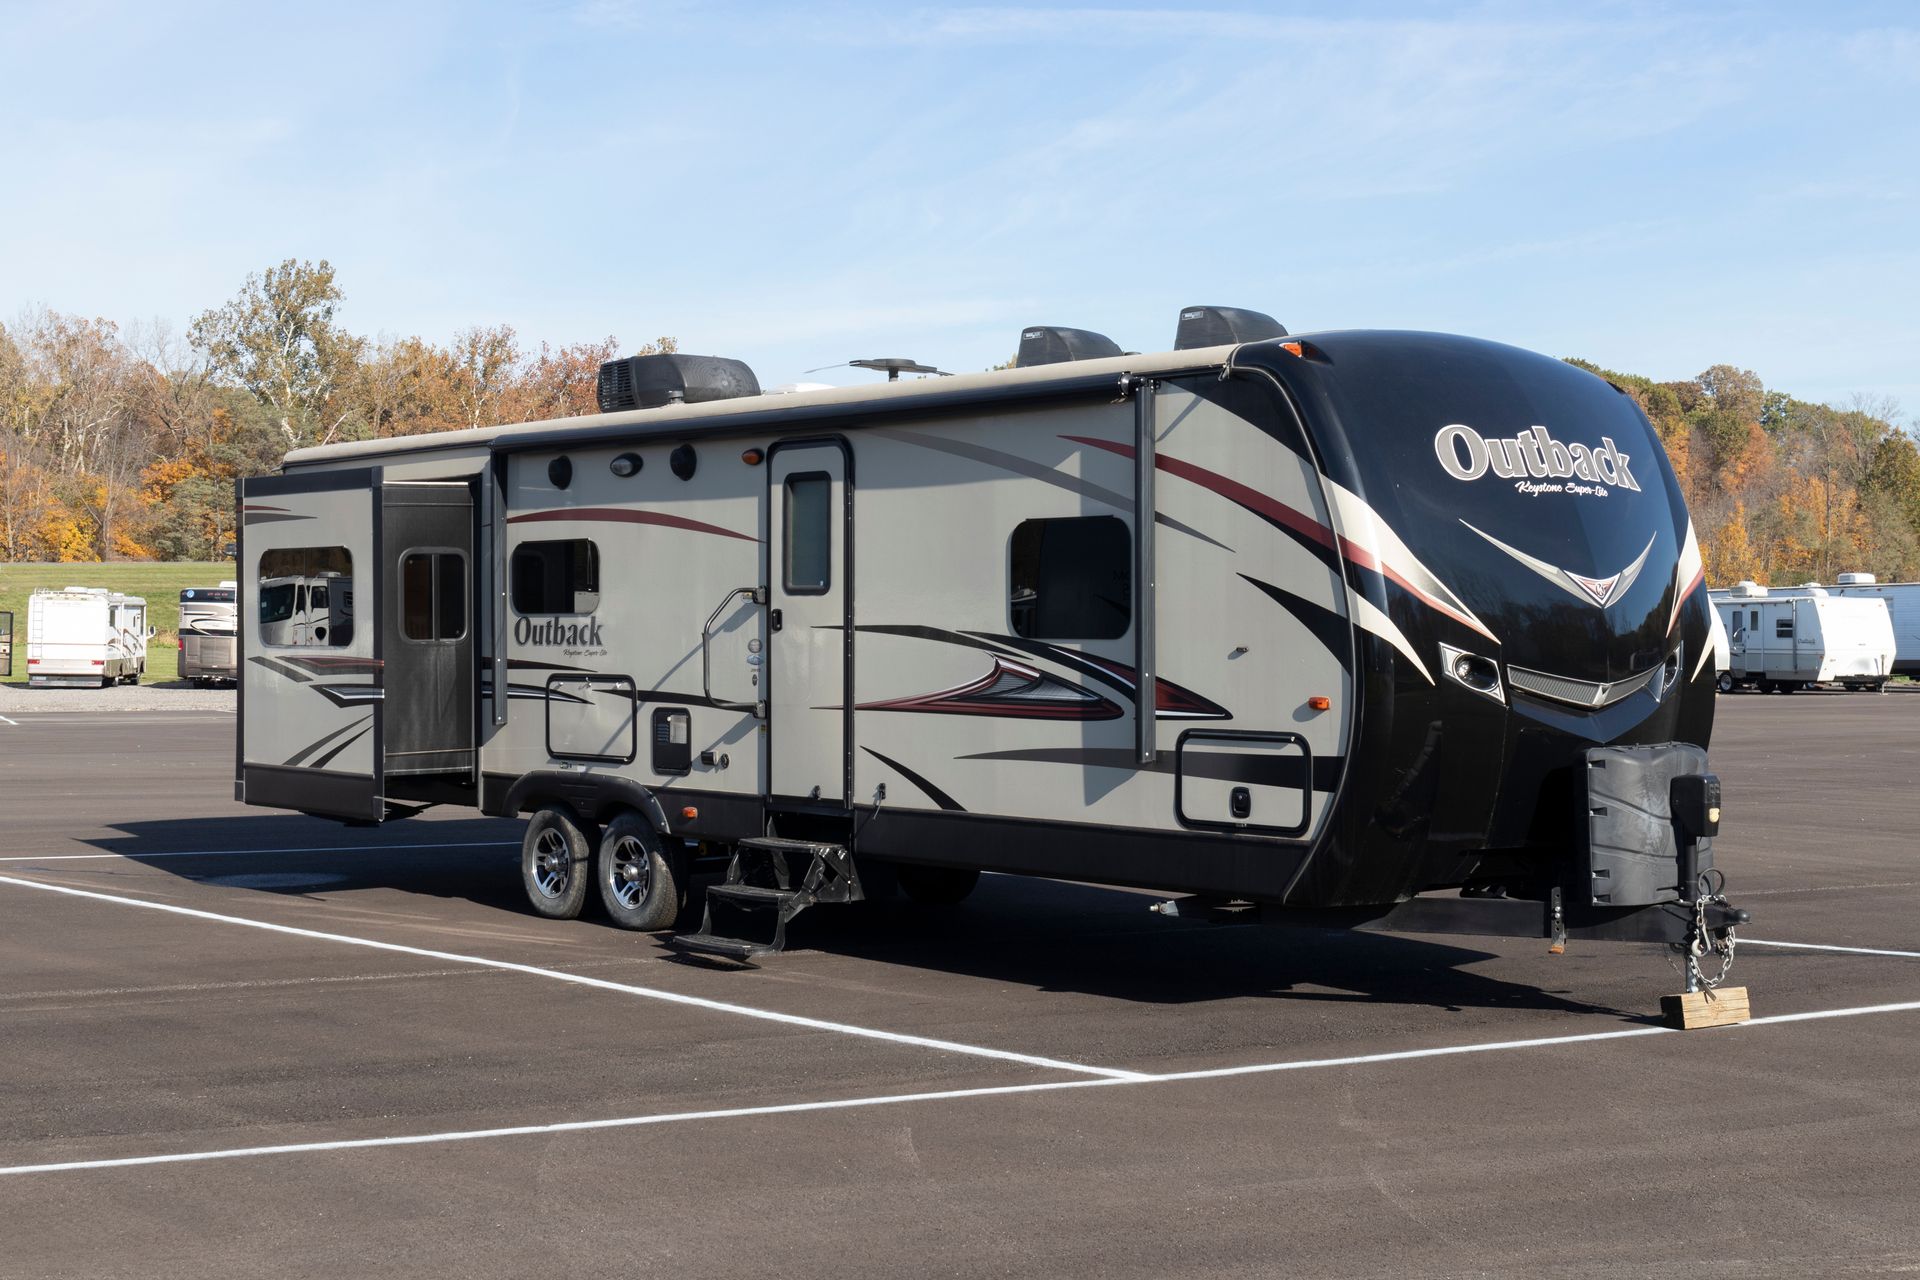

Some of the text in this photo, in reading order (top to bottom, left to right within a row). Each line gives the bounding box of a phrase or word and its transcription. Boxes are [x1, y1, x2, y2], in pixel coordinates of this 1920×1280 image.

[1434, 424, 1642, 492] Outback
[1514, 480, 1563, 498] Keystone
[514, 616, 603, 646] Outback
